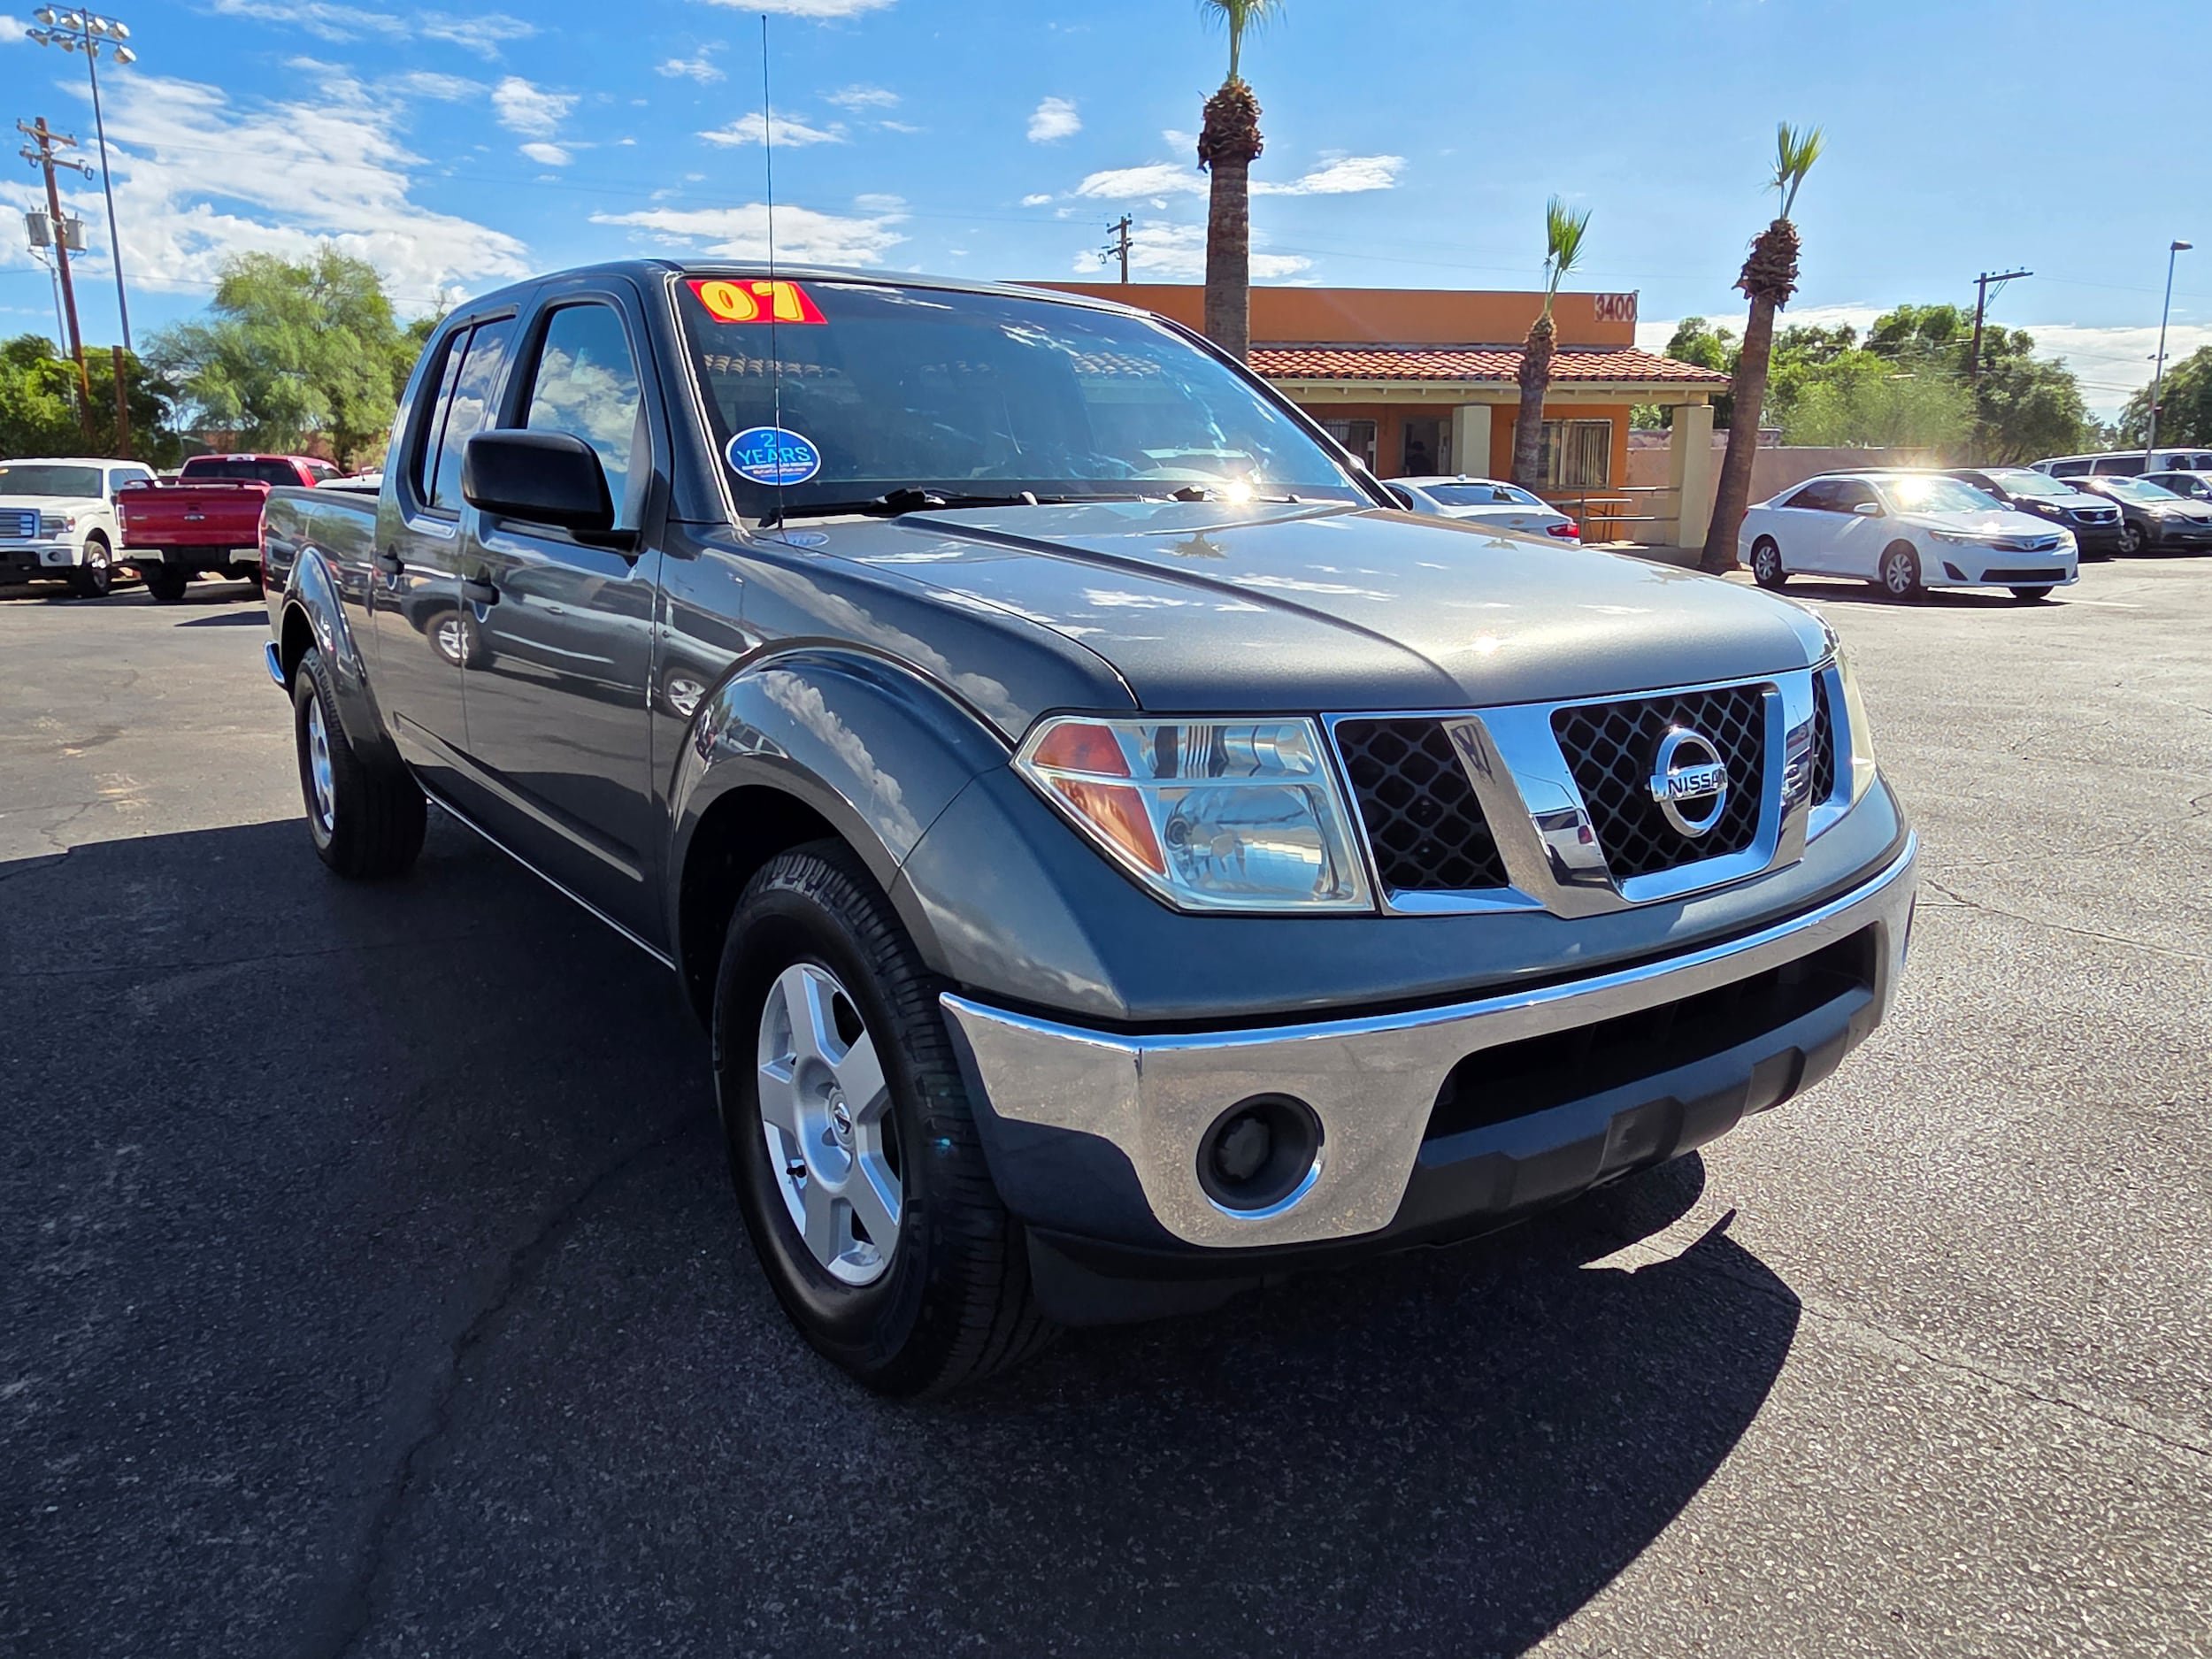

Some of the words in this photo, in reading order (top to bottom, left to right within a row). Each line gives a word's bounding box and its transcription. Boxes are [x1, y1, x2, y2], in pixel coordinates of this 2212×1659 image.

[700, 280, 804, 321] 07
[1596, 295, 1635, 320] 3400
[760, 433, 777, 448] 2
[736, 447, 810, 465] YEARS
